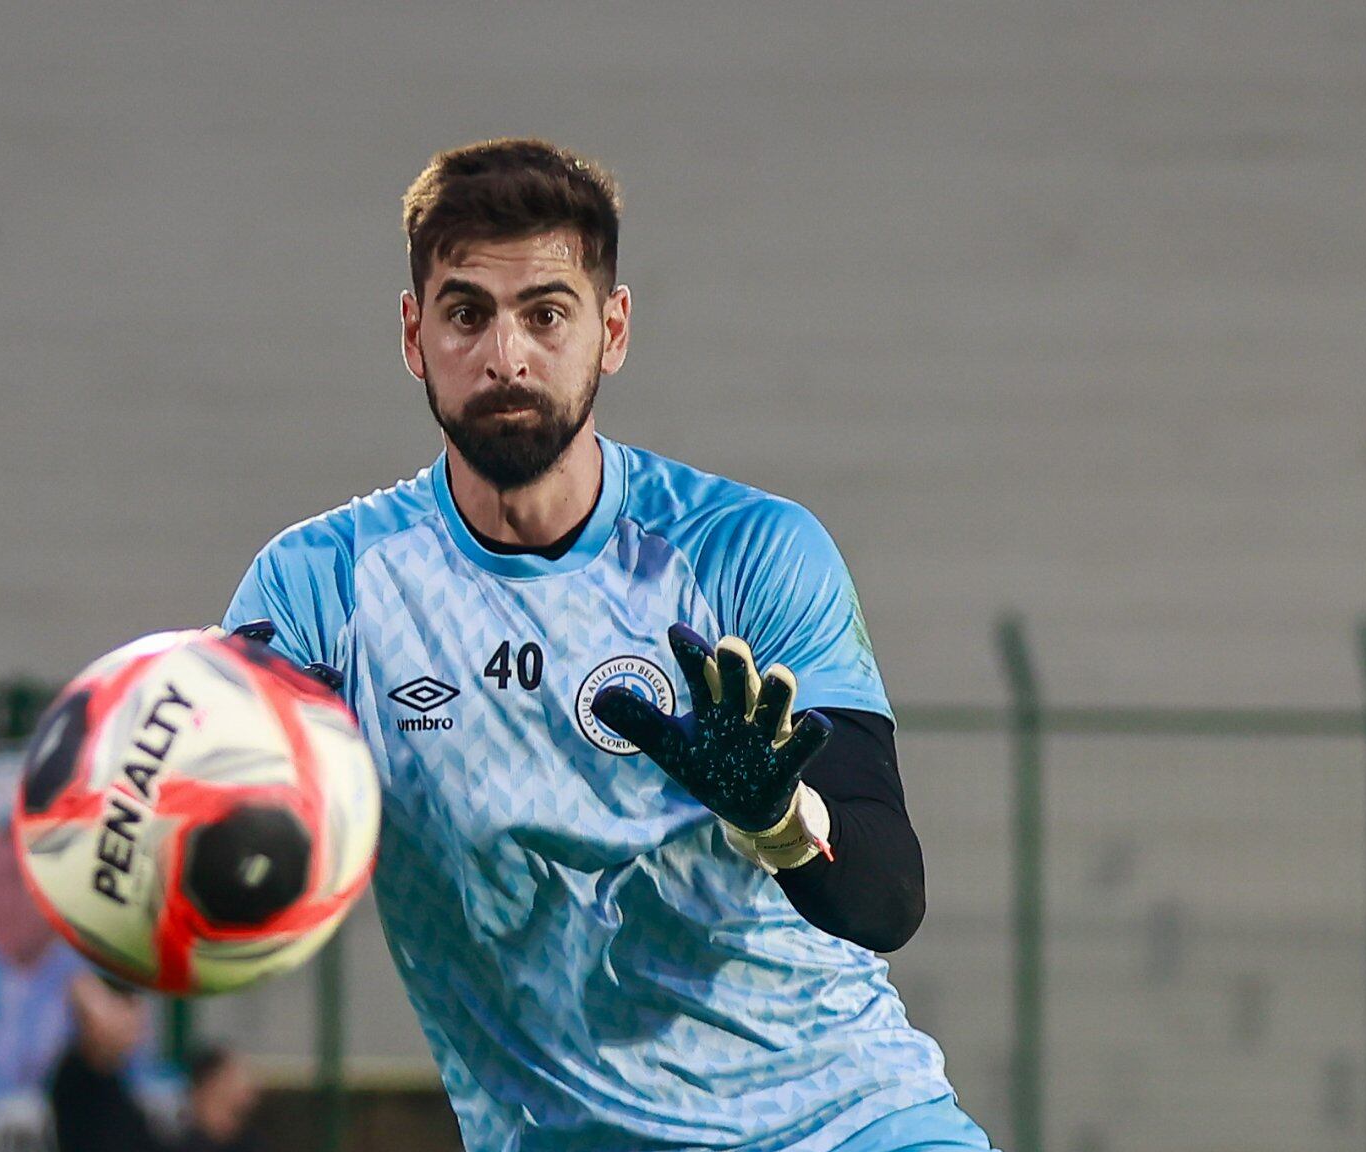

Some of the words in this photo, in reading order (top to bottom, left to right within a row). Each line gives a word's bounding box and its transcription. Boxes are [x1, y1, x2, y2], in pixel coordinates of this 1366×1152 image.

[483, 640, 544, 691] 40
[587, 661, 636, 693] ATLETICO
[396, 715, 454, 732] umbro
[581, 696, 594, 727] CLUB
[600, 735, 635, 750] CORD
[92, 681, 194, 907] PENALTY
